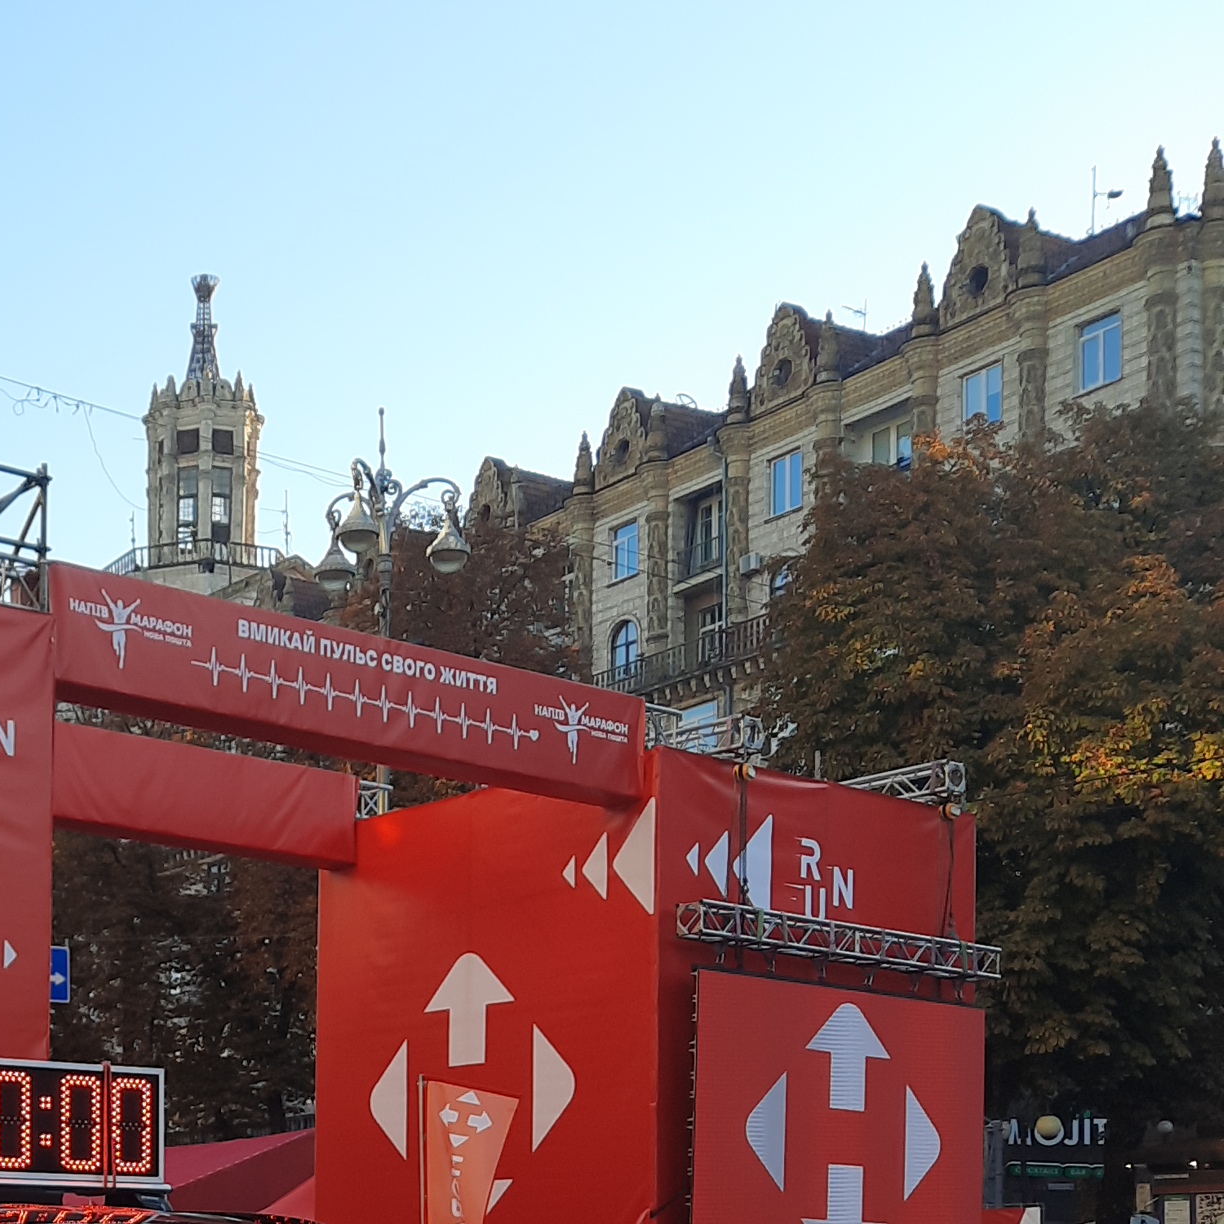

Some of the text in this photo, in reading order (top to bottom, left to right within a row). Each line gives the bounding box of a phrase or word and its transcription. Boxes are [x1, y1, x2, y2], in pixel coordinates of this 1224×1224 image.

[69, 597, 109, 618] НАПІВ
[130, 612, 192, 637] МАРАФОН
[237, 618, 497, 695] ВМИКАЙ ПУЛЬС СВОГО ЖИТТЯ
[534, 703, 565, 720] НАПІВ
[581, 714, 629, 735] МАРАФОН
